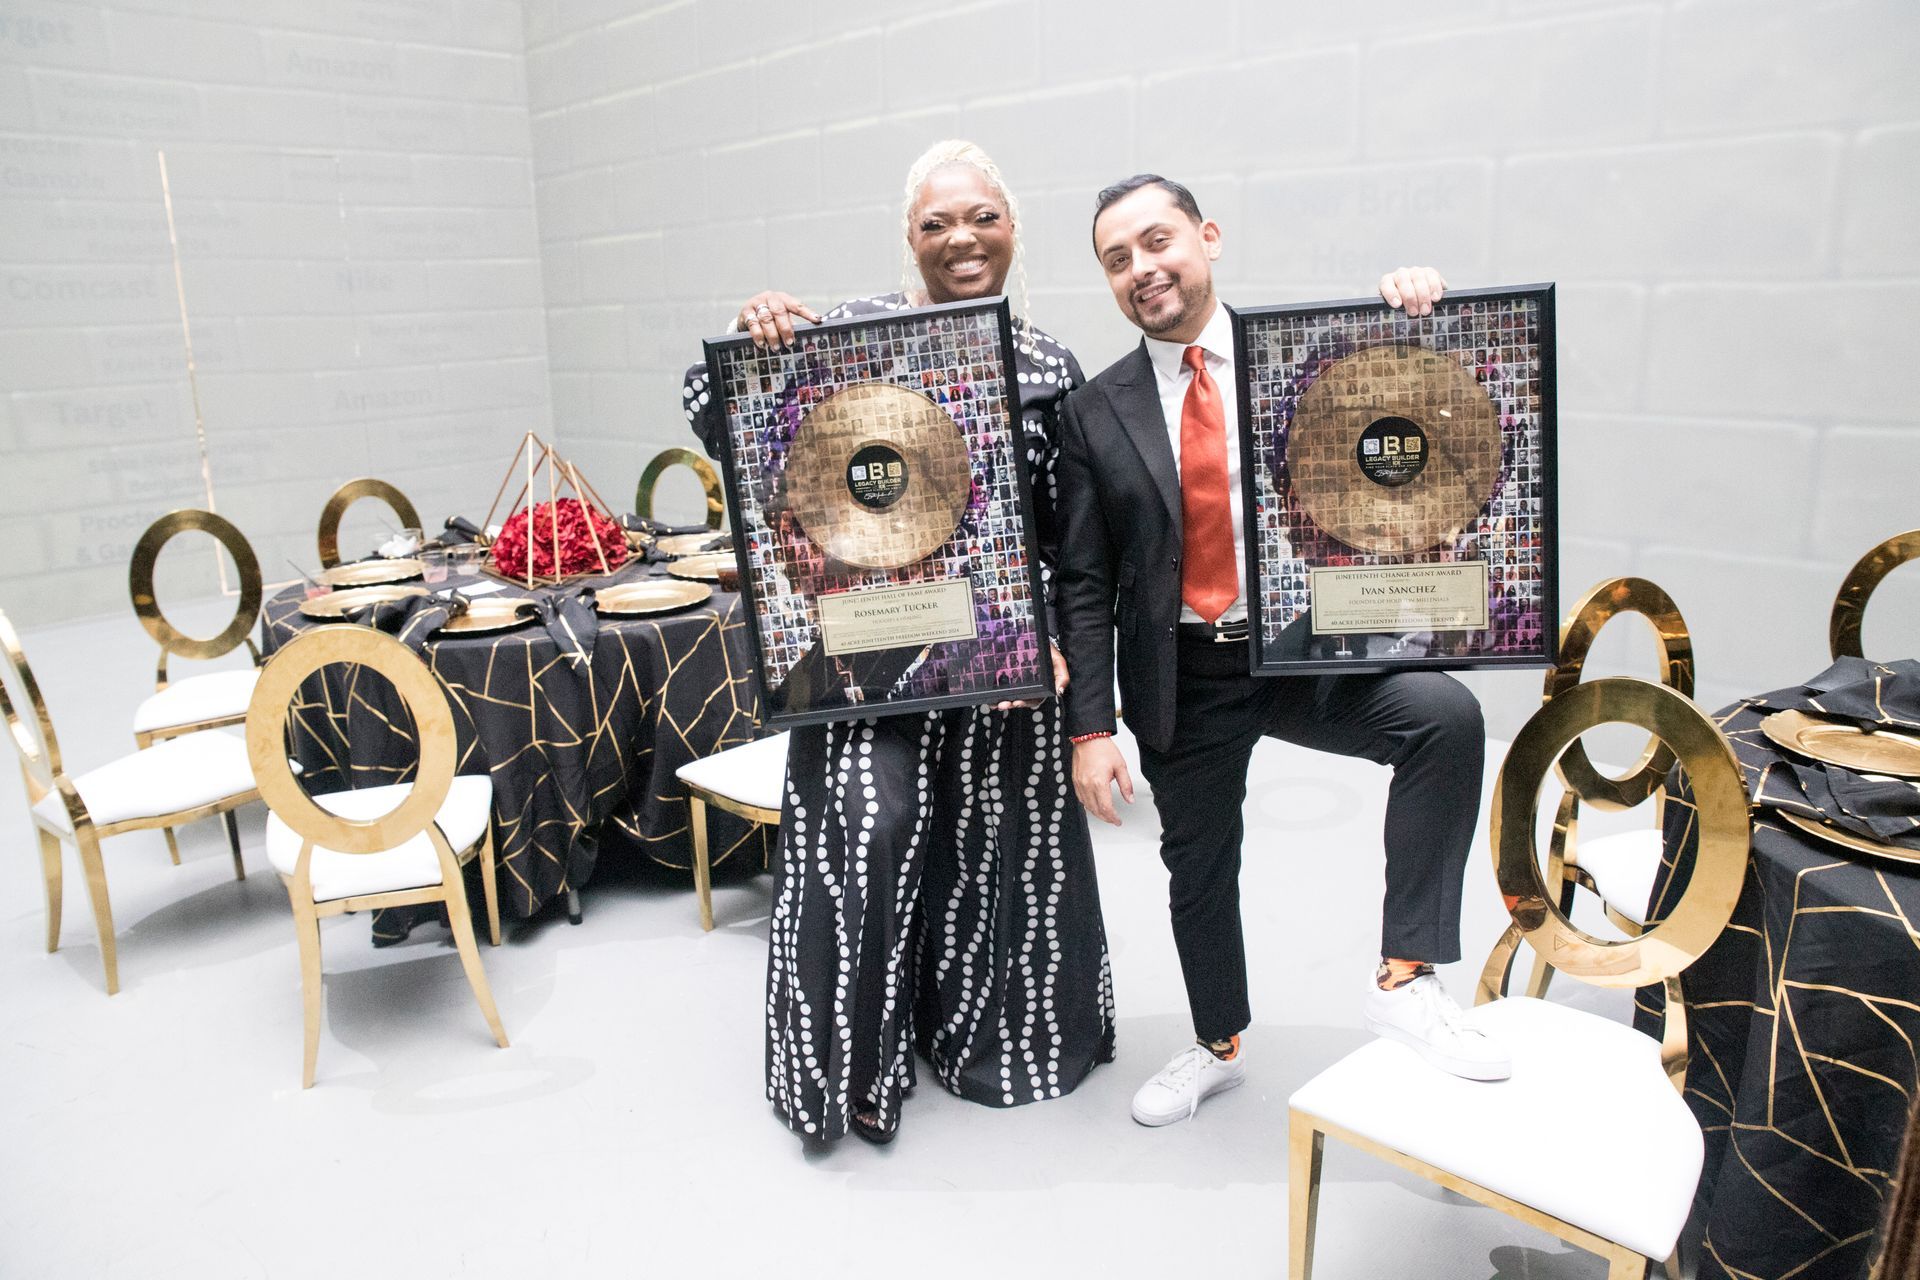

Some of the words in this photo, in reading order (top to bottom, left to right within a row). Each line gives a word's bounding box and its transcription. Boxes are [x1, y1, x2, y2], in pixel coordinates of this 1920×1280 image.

[286, 51, 395, 81] Amazon
[1358, 176, 1457, 217] Brick
[7, 275, 158, 301] Comcast
[333, 388, 433, 411] Amazon
[51, 400, 159, 429] Target
[1335, 573, 1379, 581] JUNETEENTH
[1380, 571, 1410, 579] CHANGE
[1411, 570, 1435, 578] AGENT
[1436, 569, 1462, 577] AWARD
